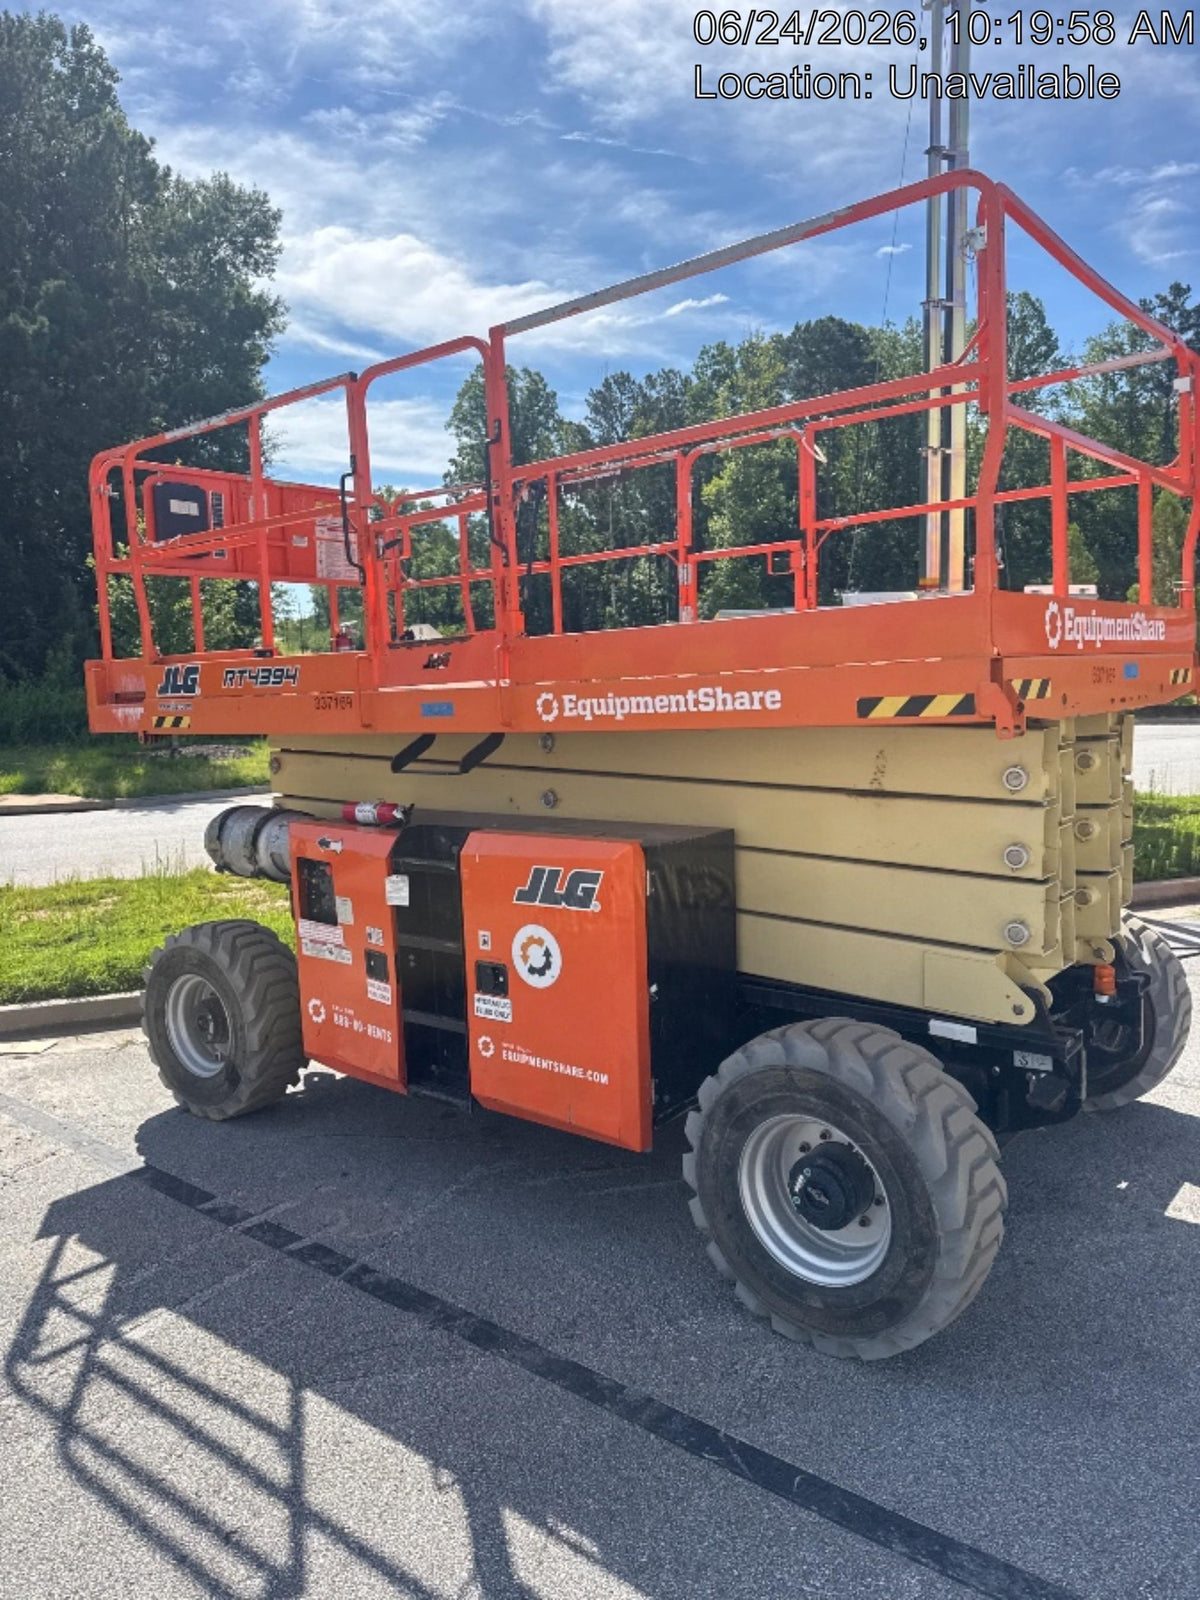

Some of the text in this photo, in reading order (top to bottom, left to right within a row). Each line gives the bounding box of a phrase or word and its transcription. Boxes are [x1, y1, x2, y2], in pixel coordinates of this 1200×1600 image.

[1064, 607, 1166, 650] EquipmentShare
[156, 664, 201, 697] JLG
[222, 665, 300, 688] RT4394
[562, 686, 782, 721] EquipmentShare
[512, 865, 604, 911] JLG
